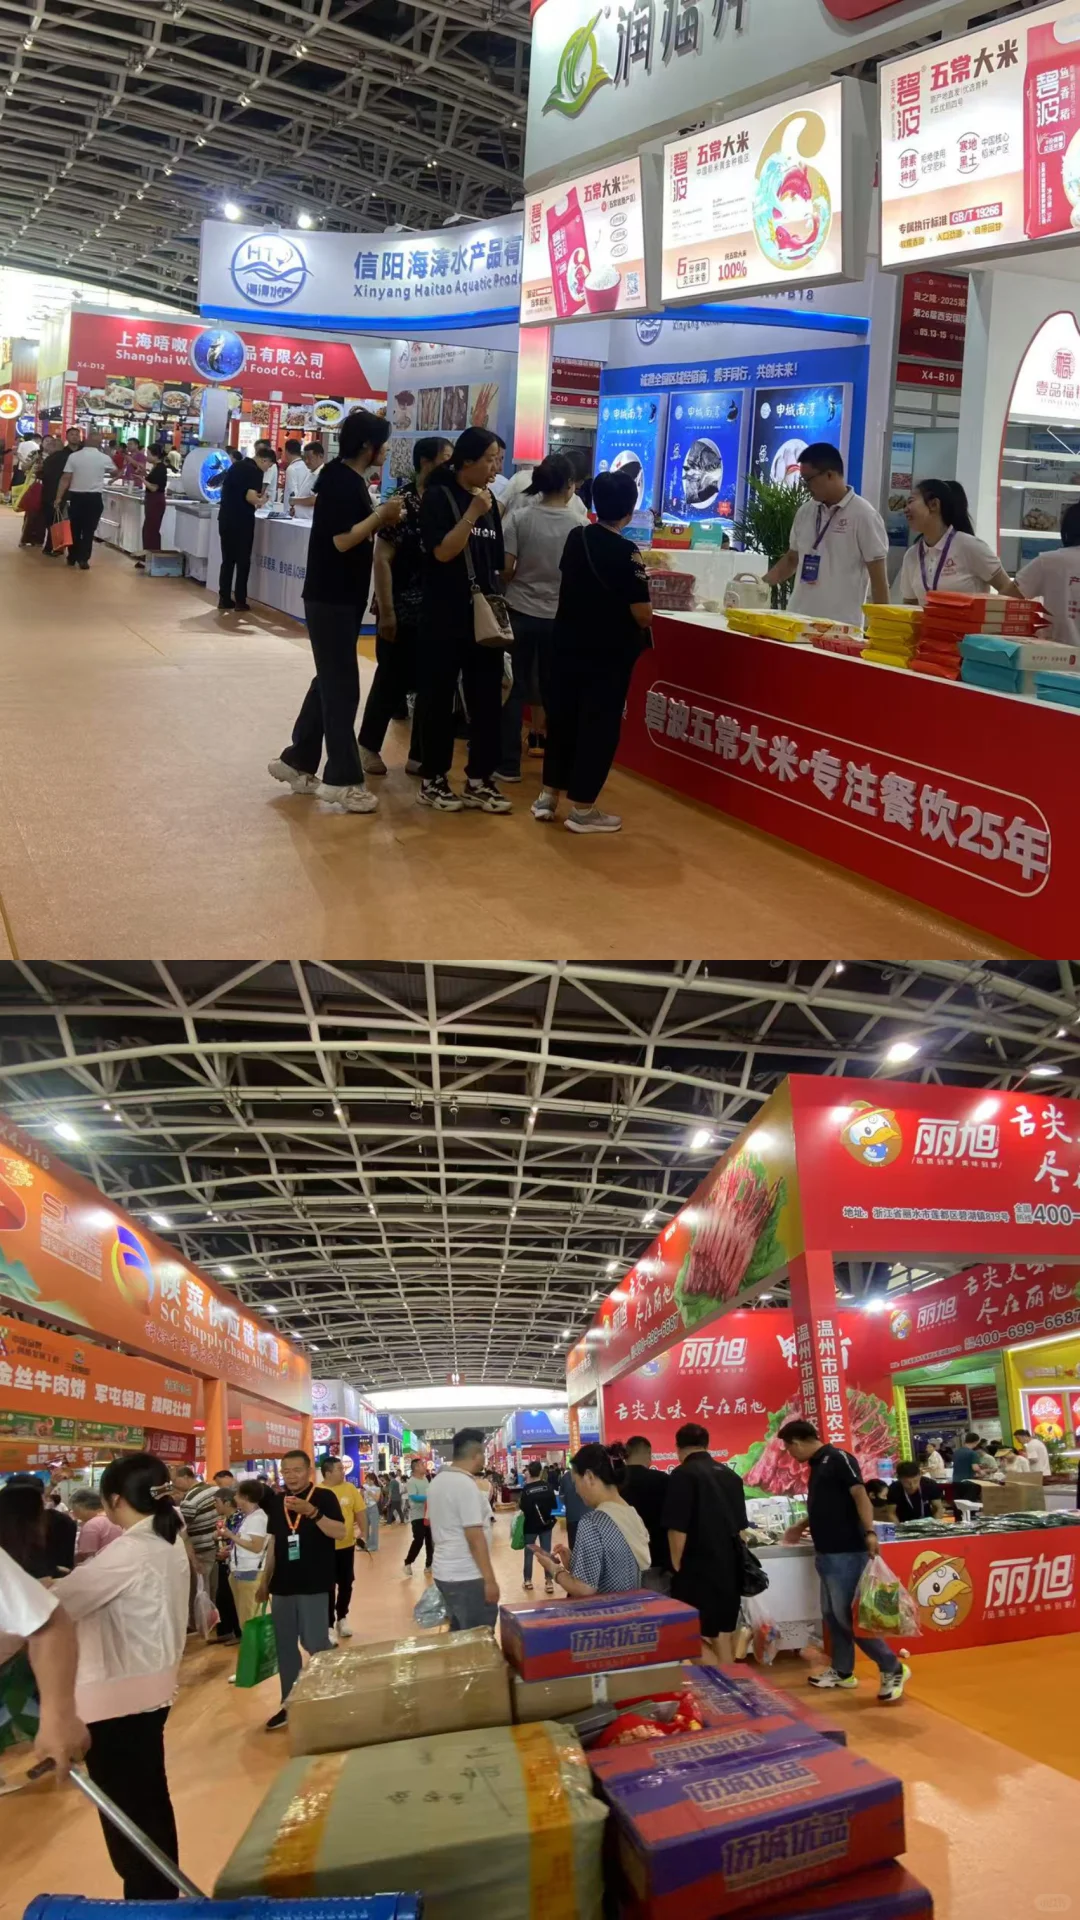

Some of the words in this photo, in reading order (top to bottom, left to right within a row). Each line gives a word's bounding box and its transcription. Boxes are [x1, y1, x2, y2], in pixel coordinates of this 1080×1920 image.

[930, 38, 1019, 91] 五常大米
[697, 130, 749, 167] 五常大米
[959, 137, 978, 154] 寒地
[981, 132, 1010, 147] 中国核心
[959, 153, 977, 169] 黑土
[584, 176, 622, 204] 五常大米
[899, 214, 948, 235] 专属执行标准
[951, 208, 975, 224] GB/T
[976, 203, 1001, 220] 19266
[718, 260, 748, 282] 100%
[353, 283, 411, 301] Xinyang
[415, 282, 453, 298] Haitao
[455, 275, 492, 295] Aquatic
[77, 361, 106, 371] X4-D12
[115, 349, 173, 365] Shanghai
[250, 364, 279, 376] Food
[281, 366, 302, 379] Co.,
[305, 370, 326, 381] Ltd.
[921, 370, 955, 383] X4-B10
[645, 690, 1050, 880] 碧波五常大米·专注餐饮25年
[1009, 1103, 1080, 1143] 舌尖
[913, 1117, 999, 1159] 丽旭
[1034, 1150, 1080, 1194] 尽
[160, 1301, 181, 1328] SC
[916, 1295, 958, 1330] 丽旭
[678, 1336, 747, 1368] 丽旭
[0, 1360, 87, 1400] 金丝牛肉饼
[614, 1399, 687, 1421] 舌尖美味
[984, 1552, 1074, 1609] 丽旭
